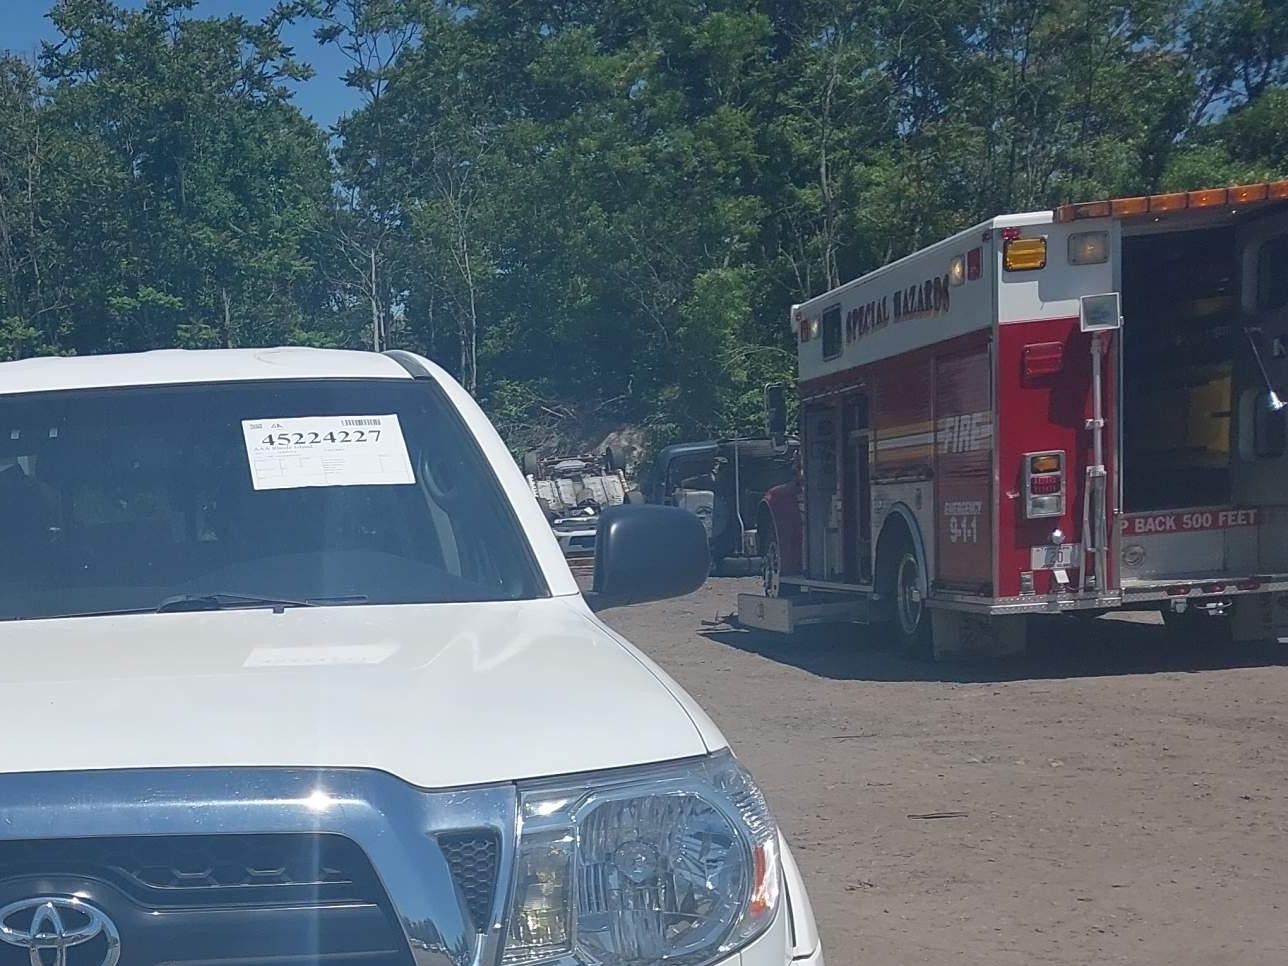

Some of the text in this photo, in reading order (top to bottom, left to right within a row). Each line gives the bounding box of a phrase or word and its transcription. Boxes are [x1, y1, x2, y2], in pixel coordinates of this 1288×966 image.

[846, 274, 950, 344] SPECIAL HAZARDS
[262, 430, 381, 446] 45224227
[938, 411, 992, 453] FIRE
[950, 515, 977, 543] 9-1-1
[1135, 516, 1177, 533] BACK
[1182, 513, 1212, 529] 500
[1218, 509, 1257, 526] FEET
